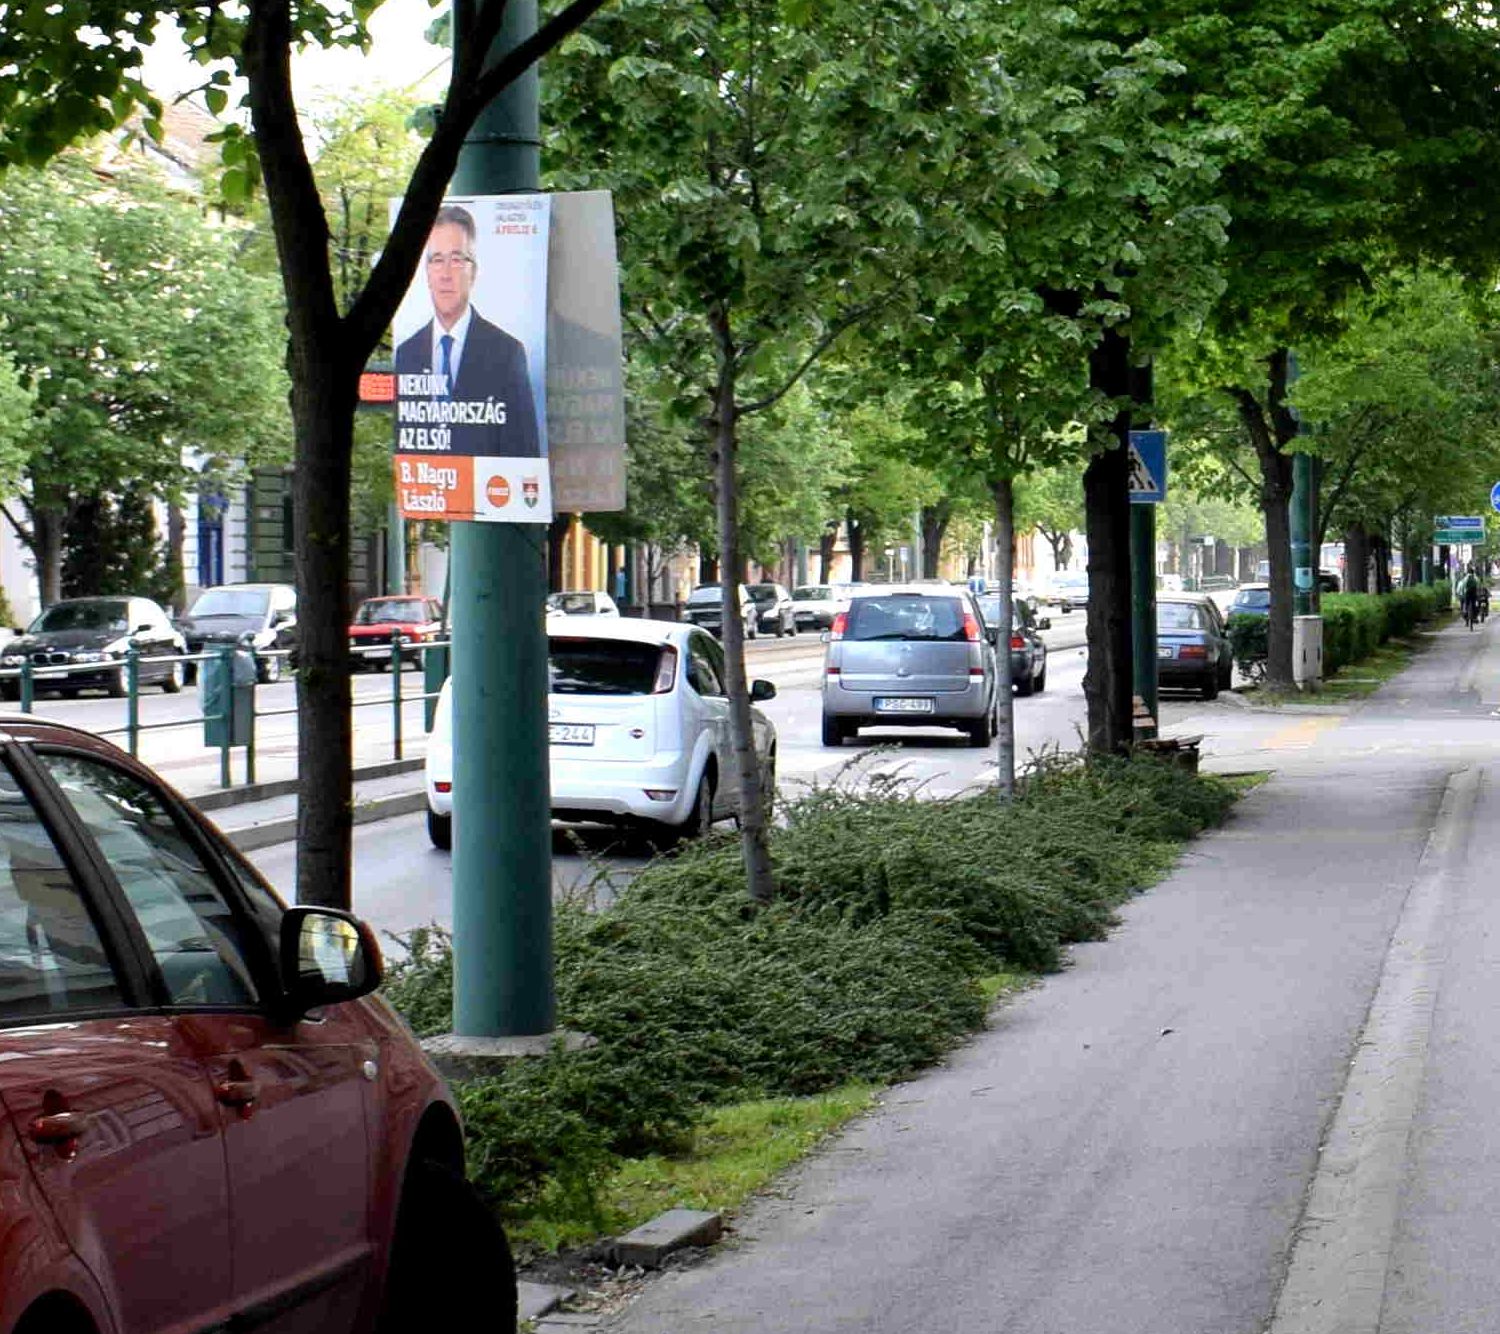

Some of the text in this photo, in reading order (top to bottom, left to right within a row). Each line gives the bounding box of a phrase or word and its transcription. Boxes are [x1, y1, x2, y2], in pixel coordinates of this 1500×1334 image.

[398, 369, 449, 396] NEKÜNK
[398, 396, 507, 424] MAGYARORSZÁG
[398, 428, 415, 449] AZ
[400, 462, 457, 490] B. Nagy
[403, 489, 447, 512] László
